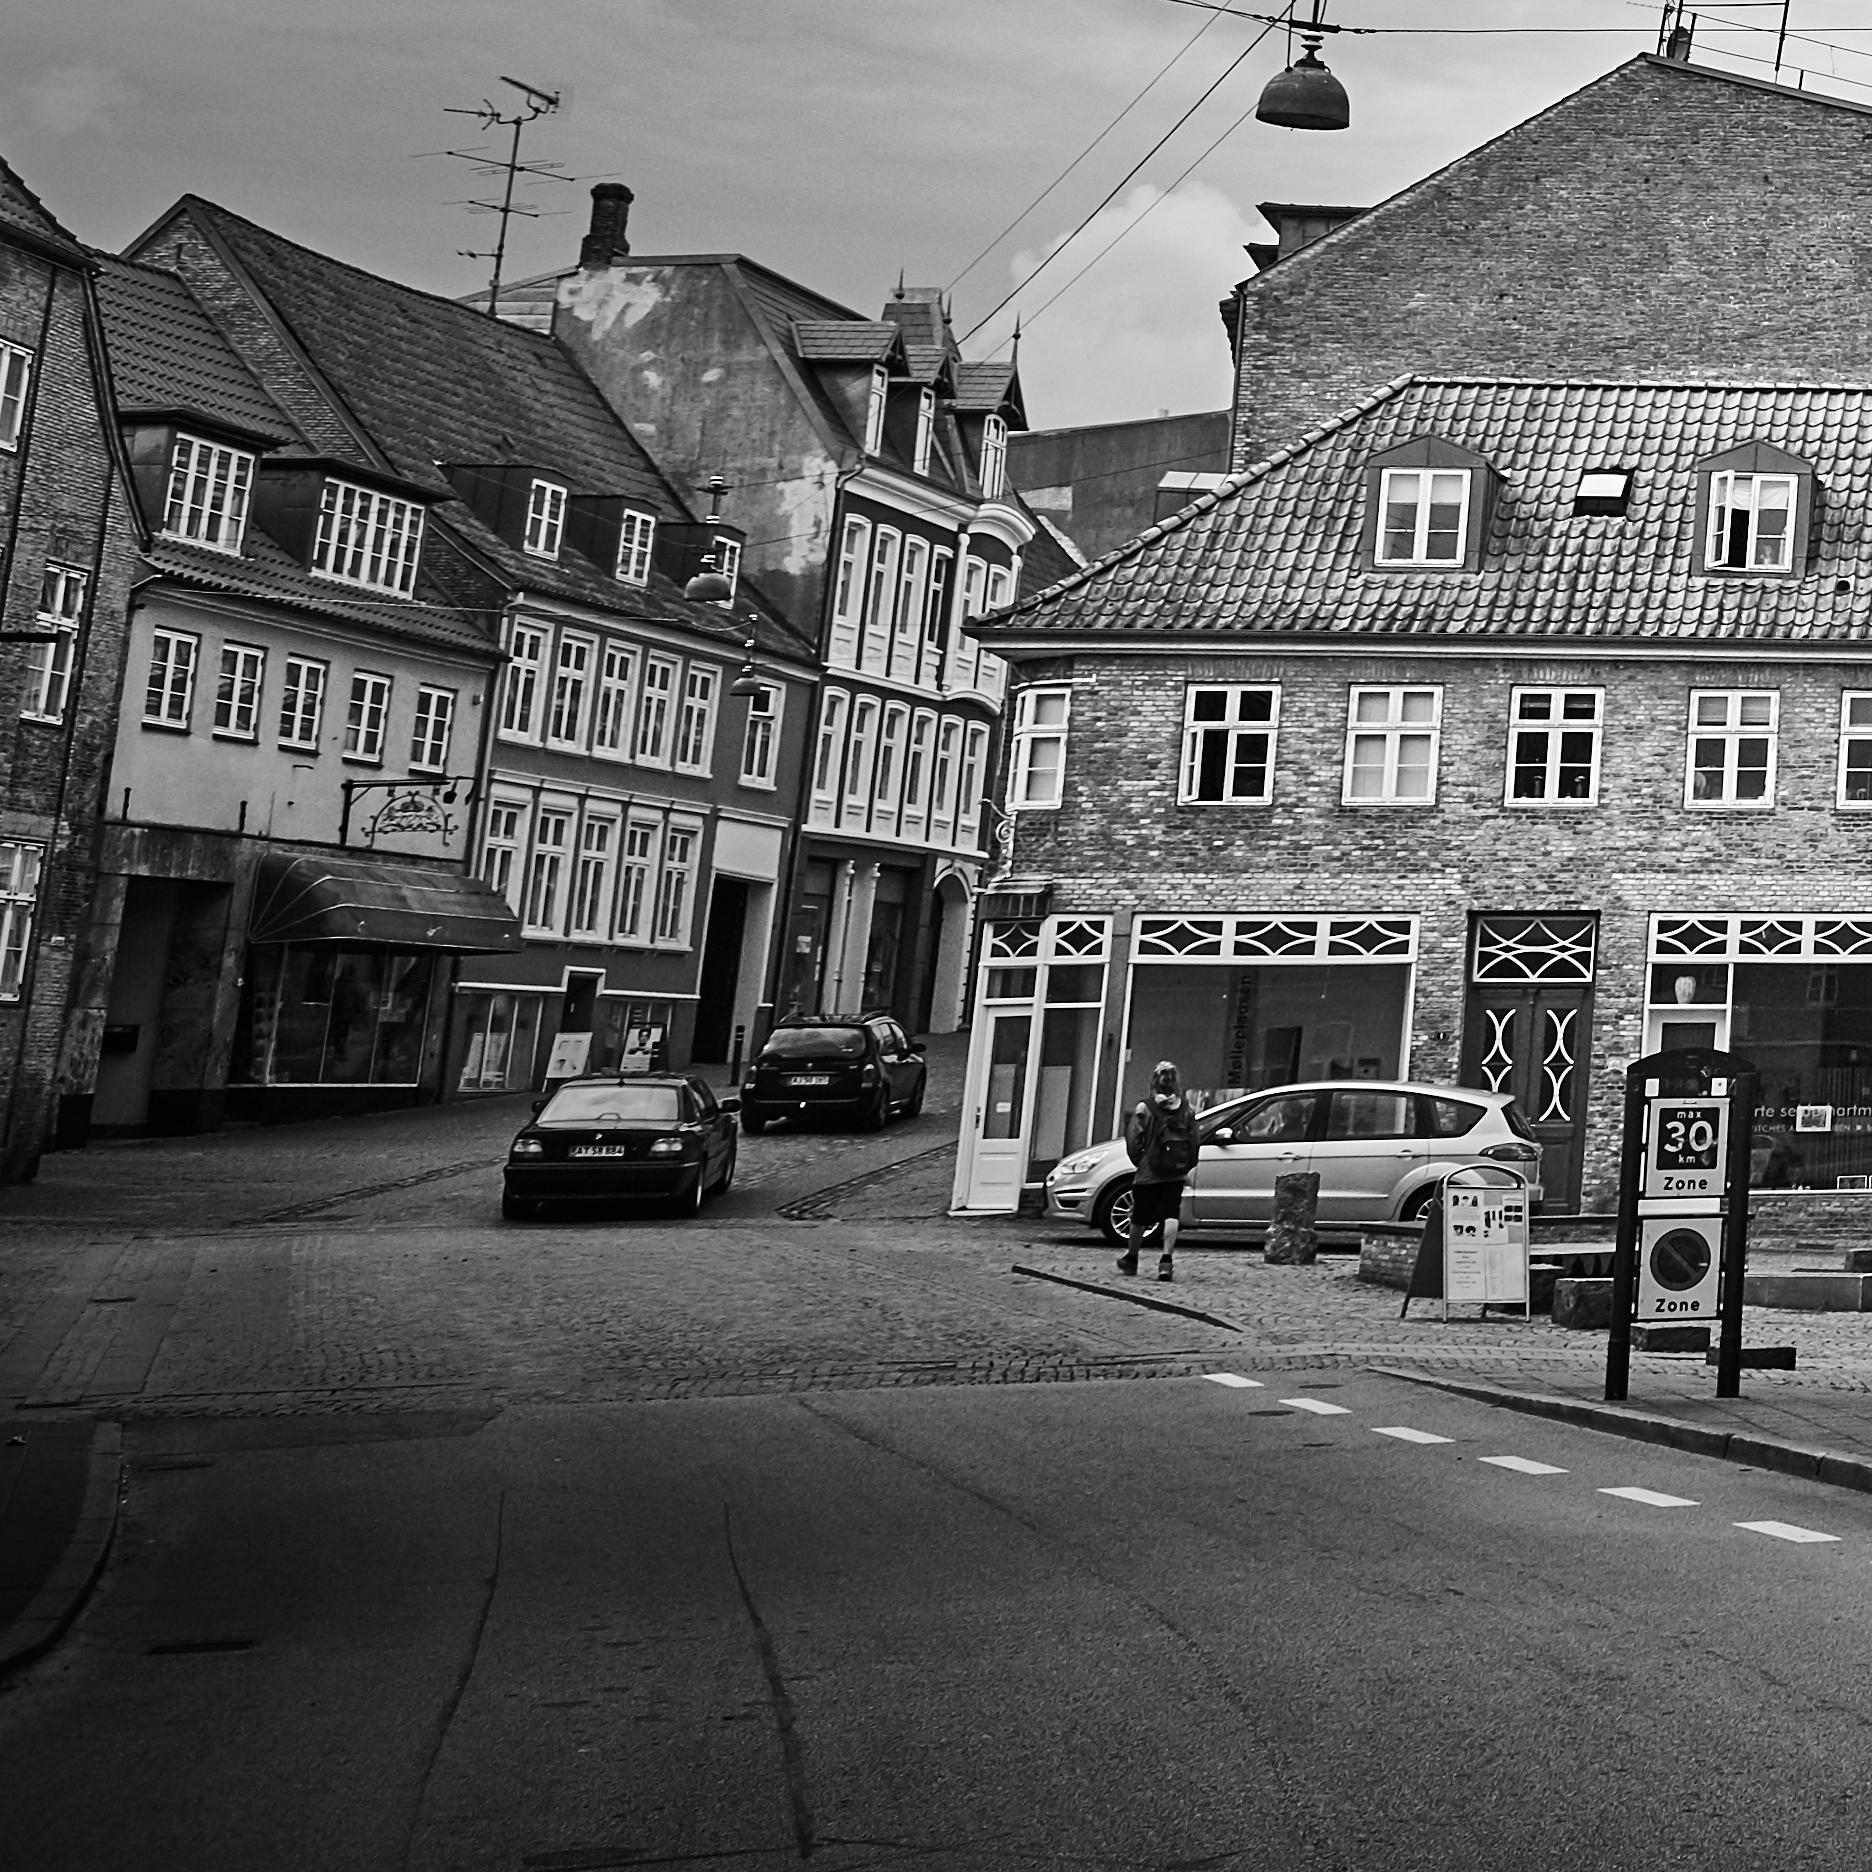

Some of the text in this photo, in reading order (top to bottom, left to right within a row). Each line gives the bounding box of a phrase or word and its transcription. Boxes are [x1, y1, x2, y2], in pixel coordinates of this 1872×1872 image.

[1676, 1110, 1702, 1119] max
[1664, 1120, 1713, 1152] 30
[1678, 1154, 1696, 1164] km
[1663, 1176, 1708, 1191] Zone
[1654, 1296, 1701, 1314] Zone
